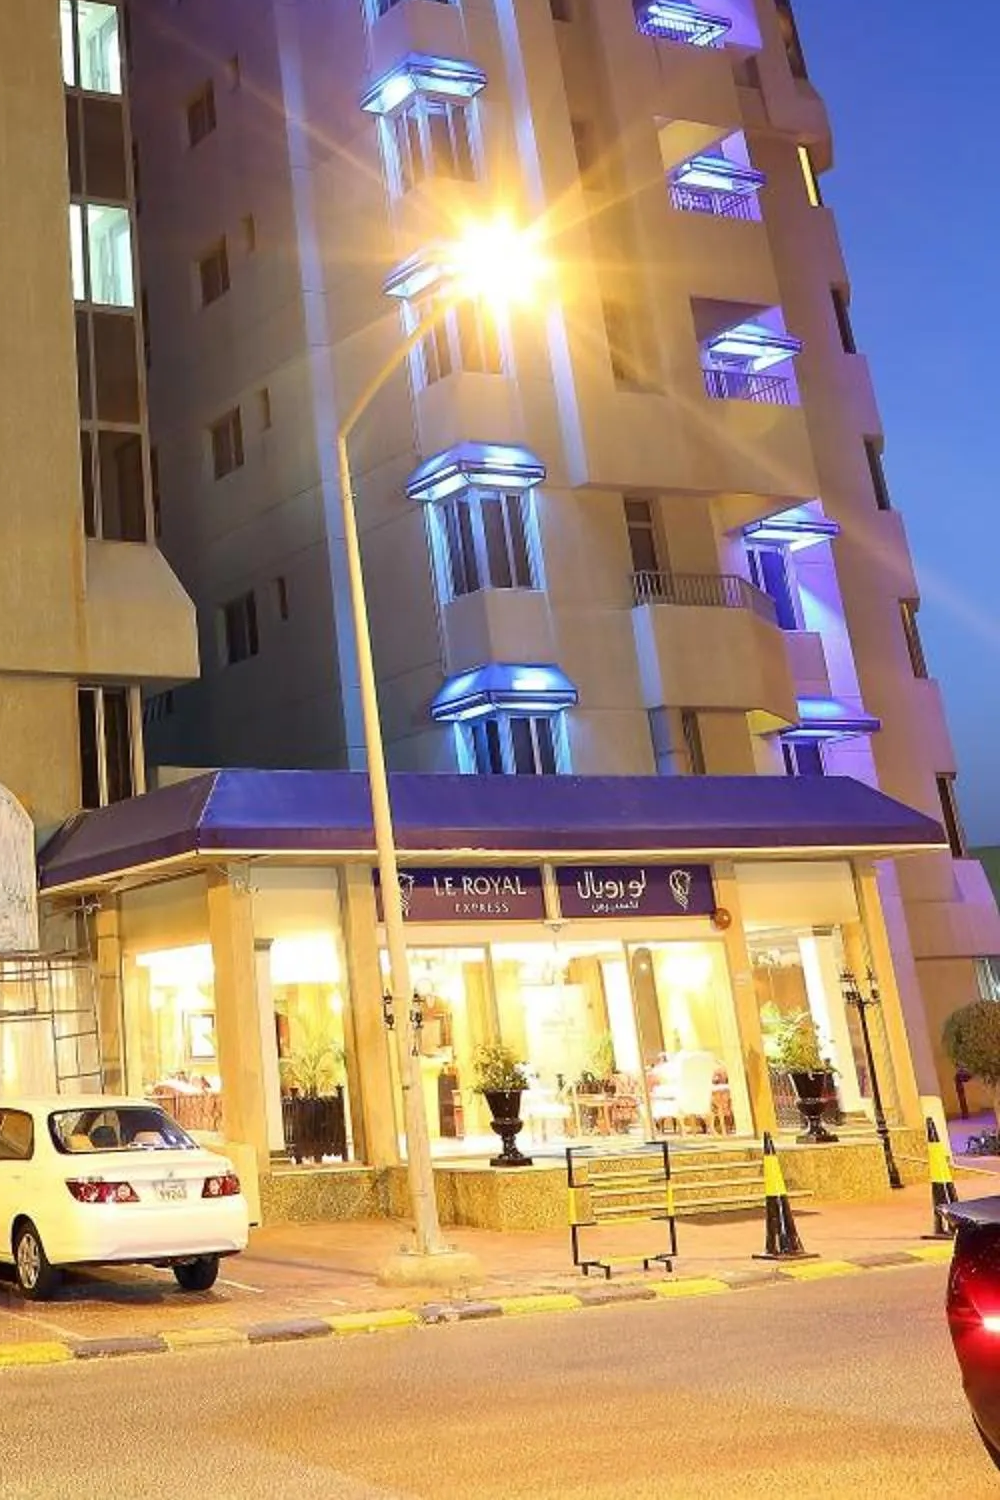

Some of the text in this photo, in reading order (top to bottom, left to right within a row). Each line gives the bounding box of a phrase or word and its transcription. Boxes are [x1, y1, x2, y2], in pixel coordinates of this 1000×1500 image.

[433, 874, 527, 897] LE ROYAL
[454, 902, 510, 914] EXPRESS
